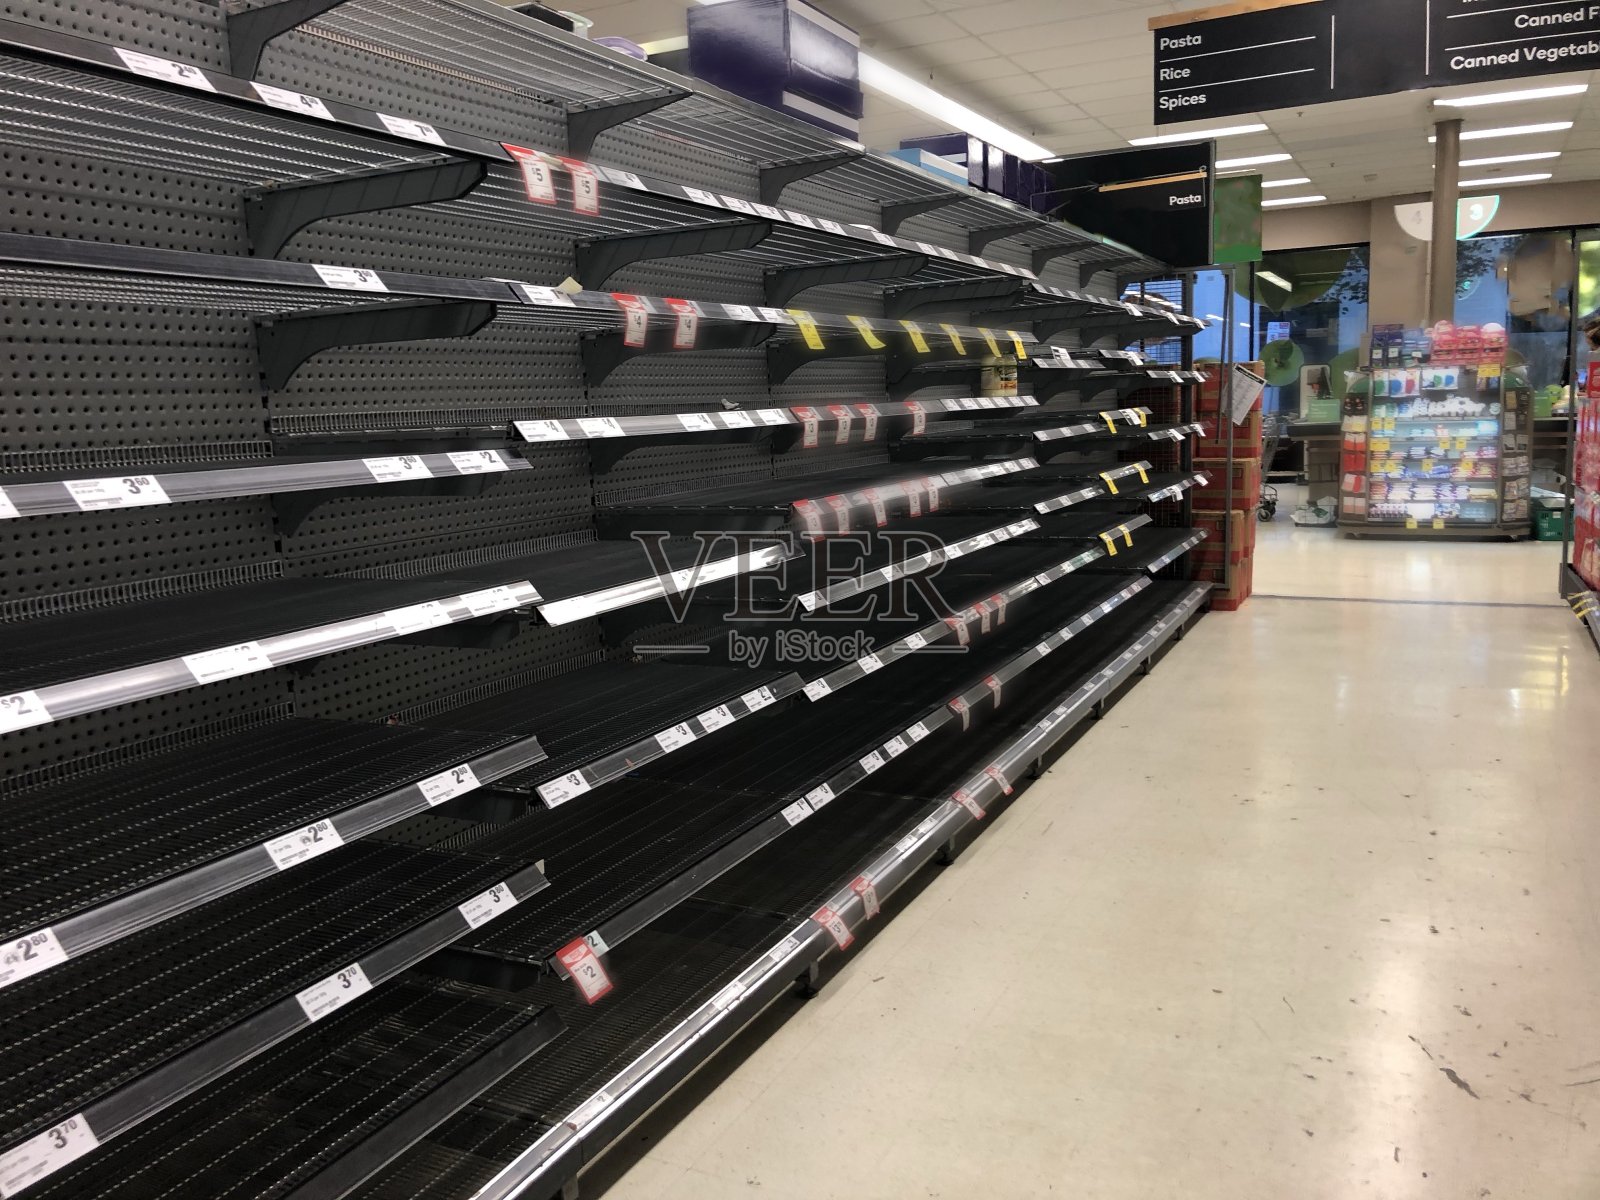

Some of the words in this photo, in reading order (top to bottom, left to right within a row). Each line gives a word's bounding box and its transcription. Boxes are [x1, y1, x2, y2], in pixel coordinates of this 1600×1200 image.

[1514, 7, 1584, 29] Canned
[1160, 34, 1202, 50] Pasta
[1450, 48, 1519, 70] Canned
[1523, 40, 1600, 62] Vegetab
[1159, 67, 1191, 81] Rice
[1159, 93, 1207, 111] Spices
[1169, 194, 1202, 206] Pasta
[1469, 203, 1484, 221] 3
[479, 450, 497, 464] $2
[1, 695, 33, 716] $2
[307, 821, 329, 843] 280
[16, 932, 48, 961] 280
[336, 966, 358, 989] 370
[48, 1118, 78, 1149] 370
